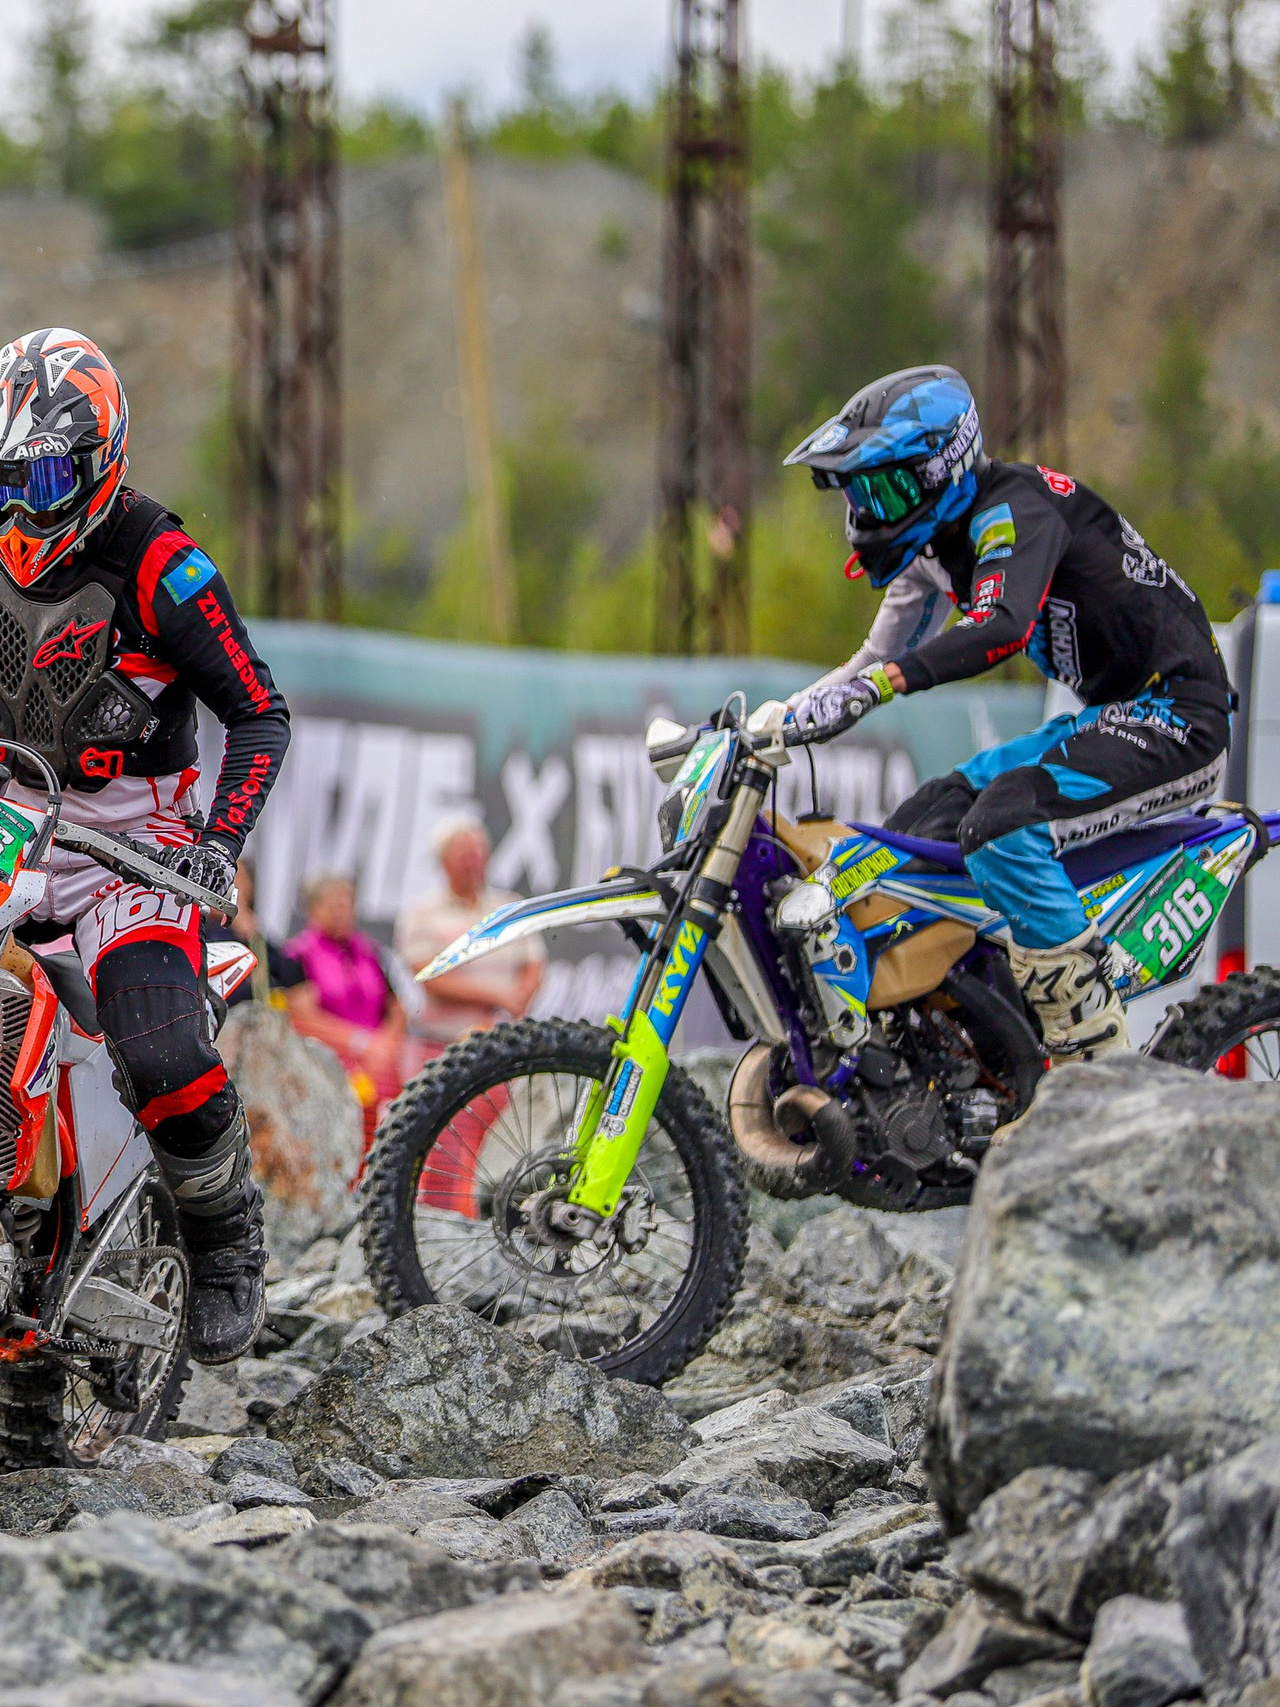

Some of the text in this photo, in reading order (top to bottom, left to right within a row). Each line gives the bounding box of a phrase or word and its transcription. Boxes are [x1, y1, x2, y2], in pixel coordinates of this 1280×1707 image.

[15, 437, 66, 459] Airoh
[212, 753, 272, 835] YaSons
[1142, 878, 1213, 967] 316
